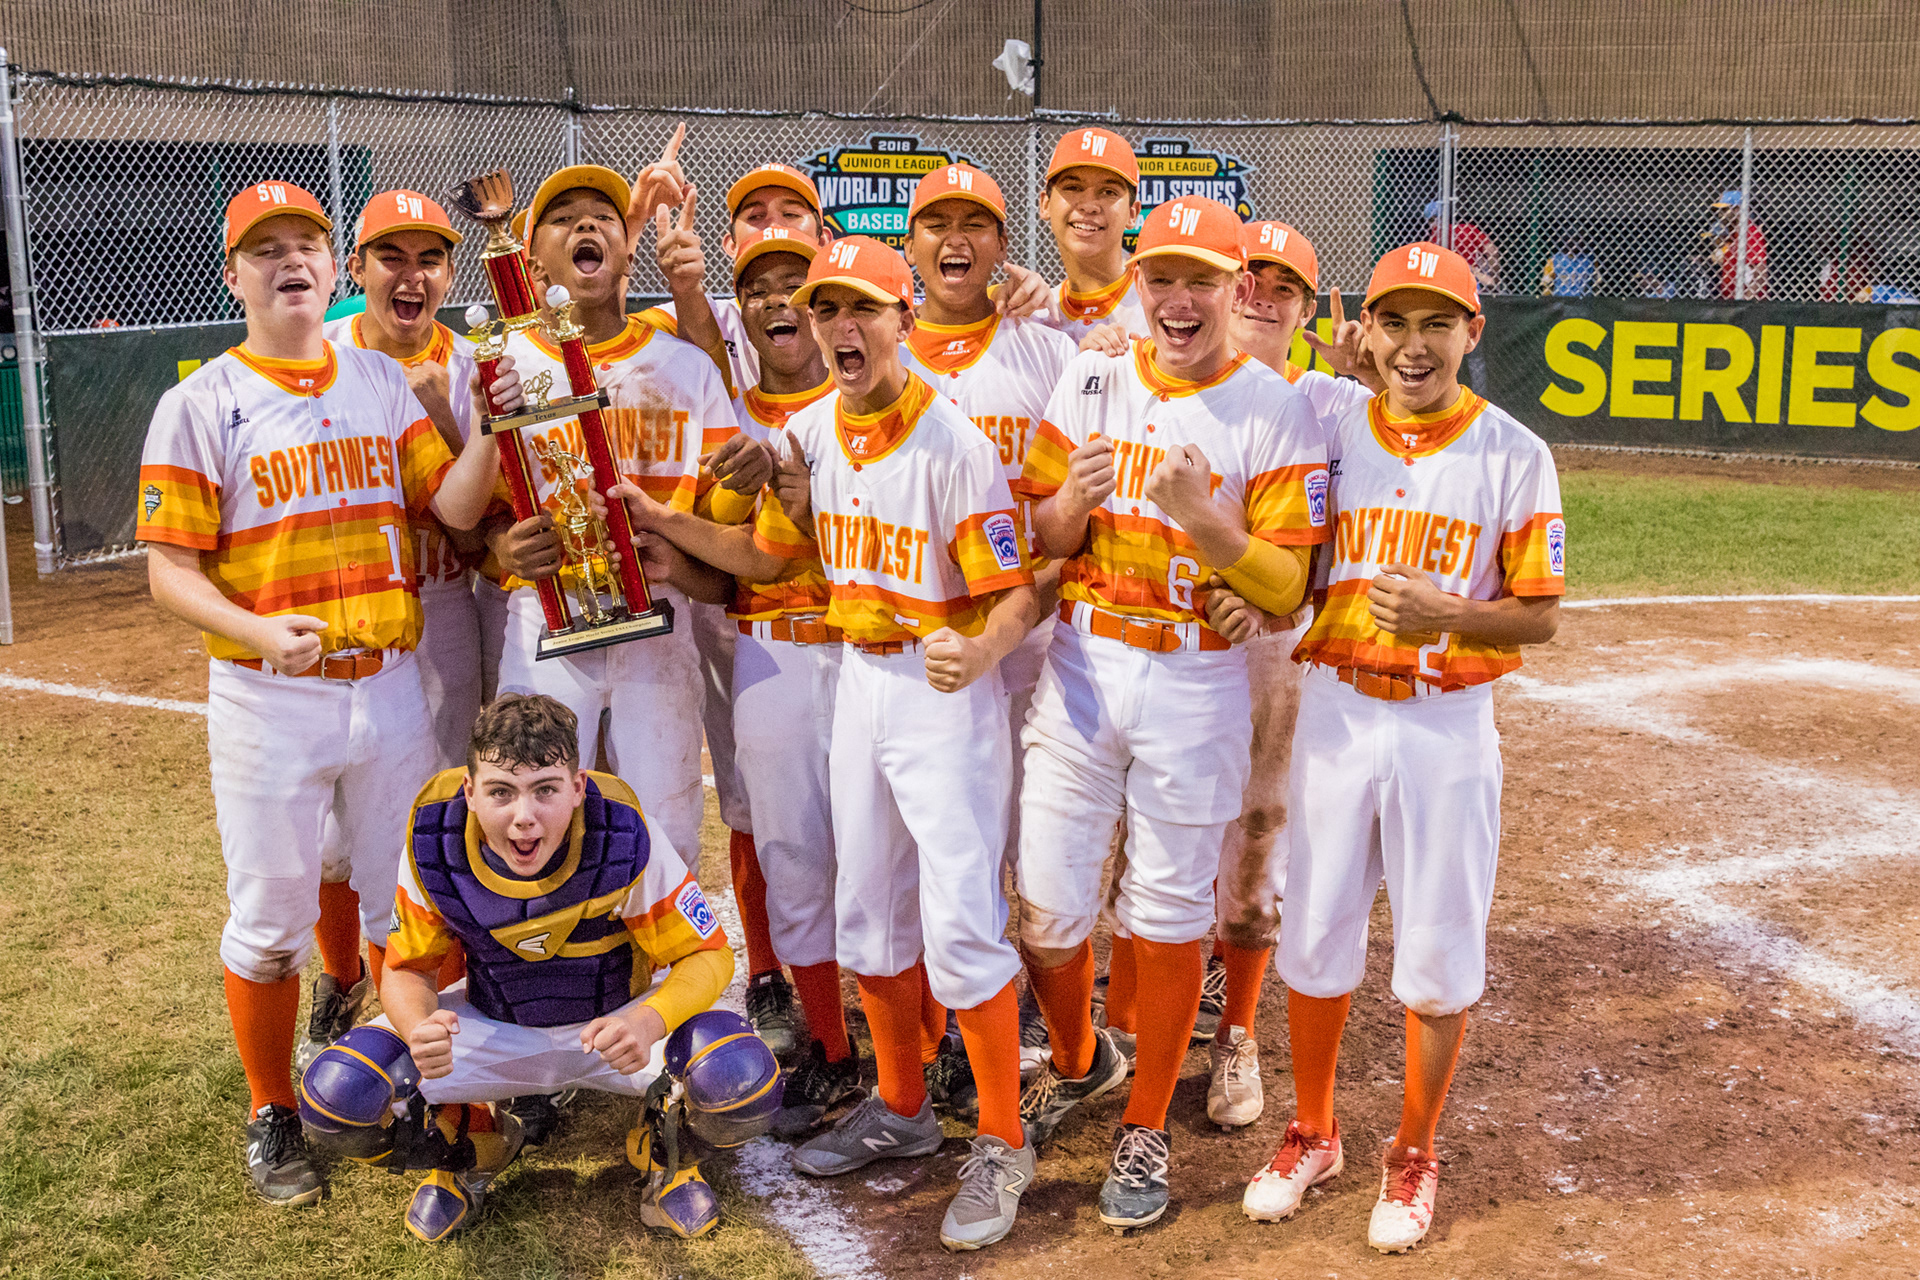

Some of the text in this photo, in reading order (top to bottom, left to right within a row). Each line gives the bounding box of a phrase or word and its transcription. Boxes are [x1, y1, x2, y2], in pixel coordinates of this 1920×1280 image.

[878, 140, 911, 151] 2018
[1081, 131, 1108, 157] SW
[1152, 144, 1182, 154] 2018
[844, 157, 943, 170] JUNIOR LEAGUE
[1137, 161, 1213, 172] NIOR LEAGUE
[818, 176, 891, 208] WORLD
[947, 167, 973, 191] SW
[256, 184, 287, 204] SW
[395, 193, 423, 220] SW
[848, 213, 909, 230] BASEB
[1169, 202, 1202, 236] SW
[763, 227, 789, 240] SW
[1260, 223, 1289, 253] SW
[828, 241, 861, 270] SW
[1407, 246, 1440, 278] SW
[1539, 318, 1920, 432] SERIES
[535, 412, 557, 421] Texas
[250, 436, 395, 508] SOUTHWES
[1331, 507, 1482, 581] OUTHWEST
[1167, 555, 1200, 610] 6
